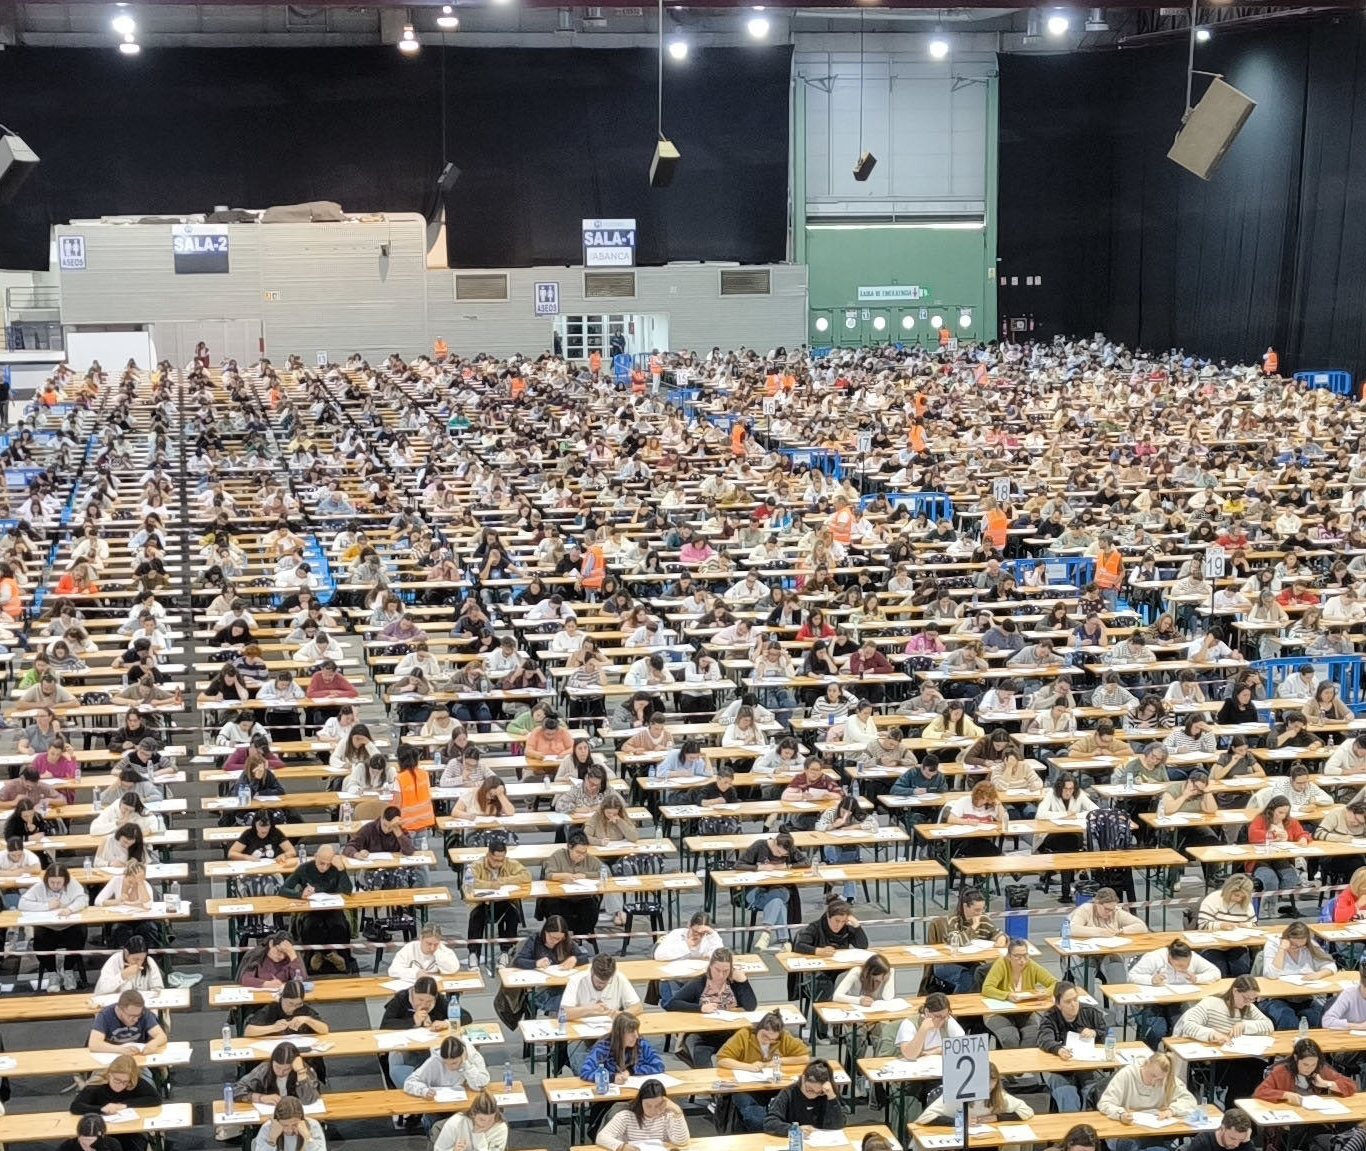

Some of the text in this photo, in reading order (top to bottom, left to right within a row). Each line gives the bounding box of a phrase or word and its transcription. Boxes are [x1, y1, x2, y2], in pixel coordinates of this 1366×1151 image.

[174, 236, 228, 251] SALA-2
[584, 231, 635, 246] SALA-1
[62, 258, 84, 267] ASEOS
[593, 252, 630, 261] ABANCA
[537, 304, 557, 313] ASEOS
[764, 402, 774, 414] 16
[858, 438, 870, 451] 17
[996, 485, 1008, 501] 18
[1207, 557, 1223, 576] 19
[944, 1037, 986, 1055] PORTA
[955, 1055, 976, 1099] 2
